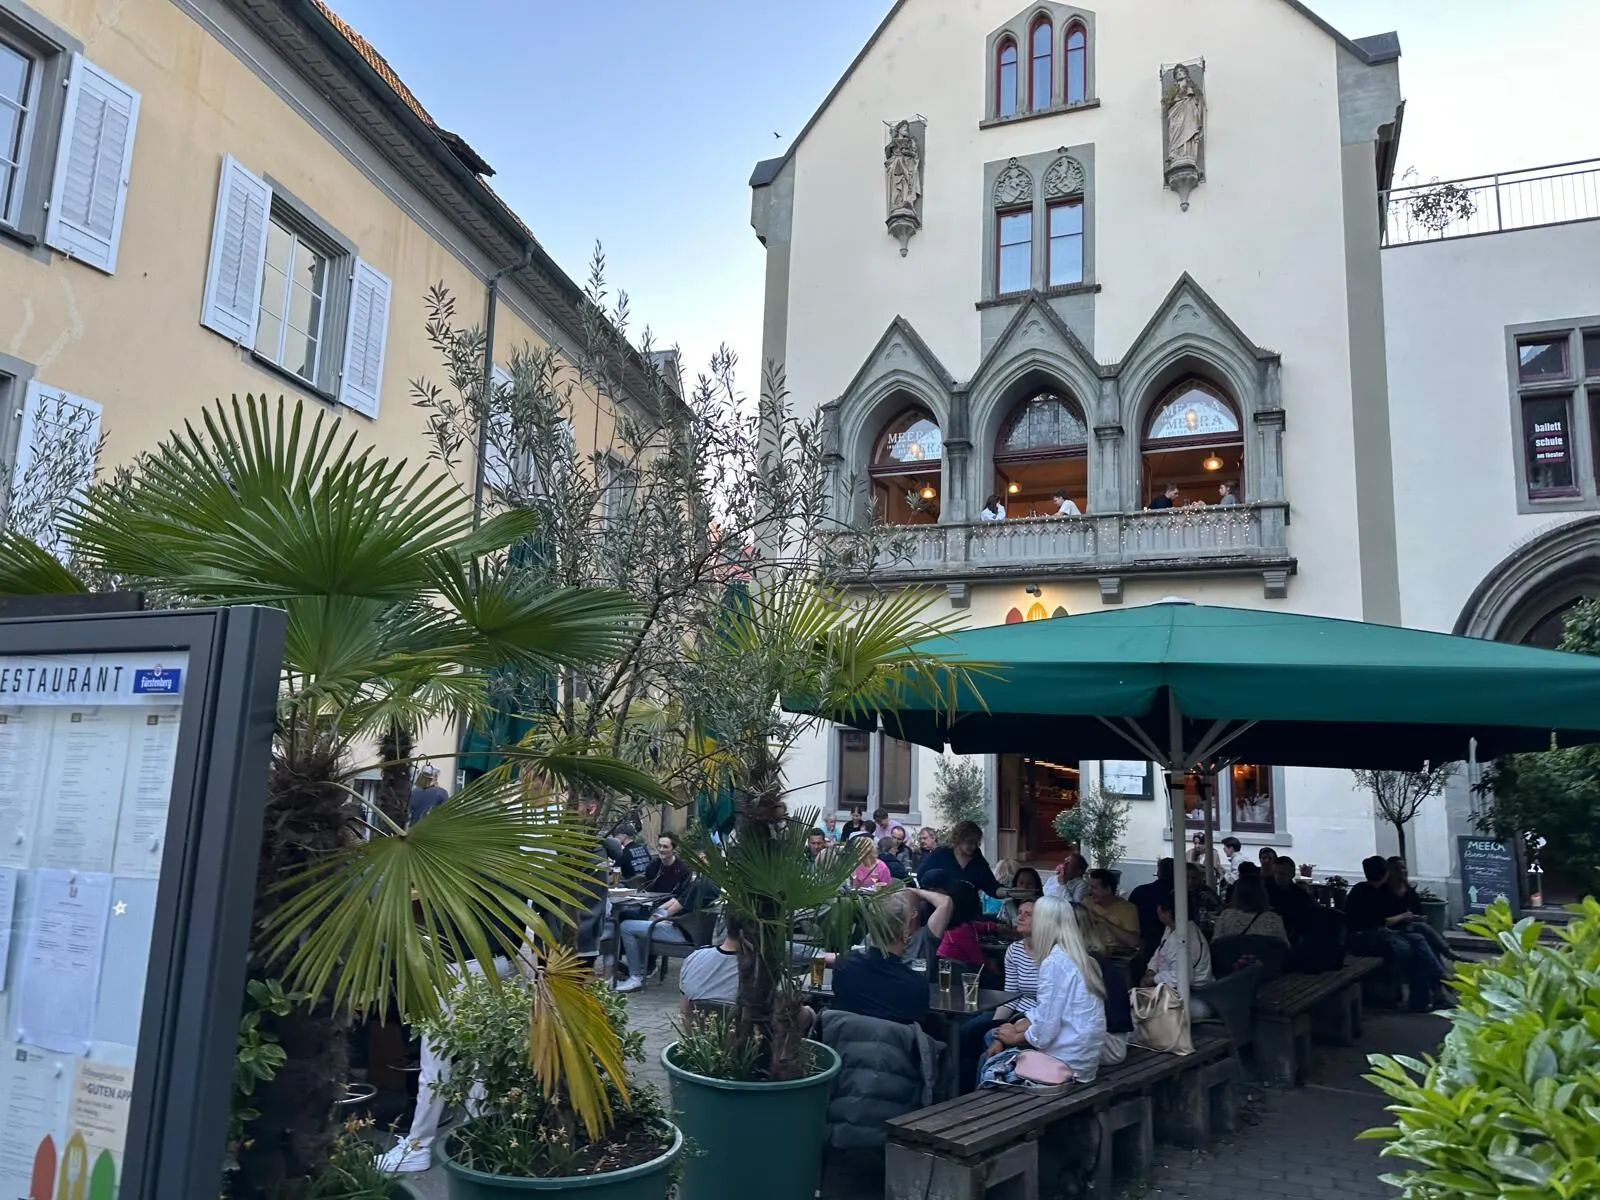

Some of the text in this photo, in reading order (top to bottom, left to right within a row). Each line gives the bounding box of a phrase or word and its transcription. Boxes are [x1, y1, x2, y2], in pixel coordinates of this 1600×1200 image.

[1166, 415, 1223, 430] MERA
[1534, 421, 1562, 432] ballett
[1535, 436, 1563, 447] schule
[0, 666, 124, 693] ESTAURANT
[87, 1082, 116, 1098] GUTEN
